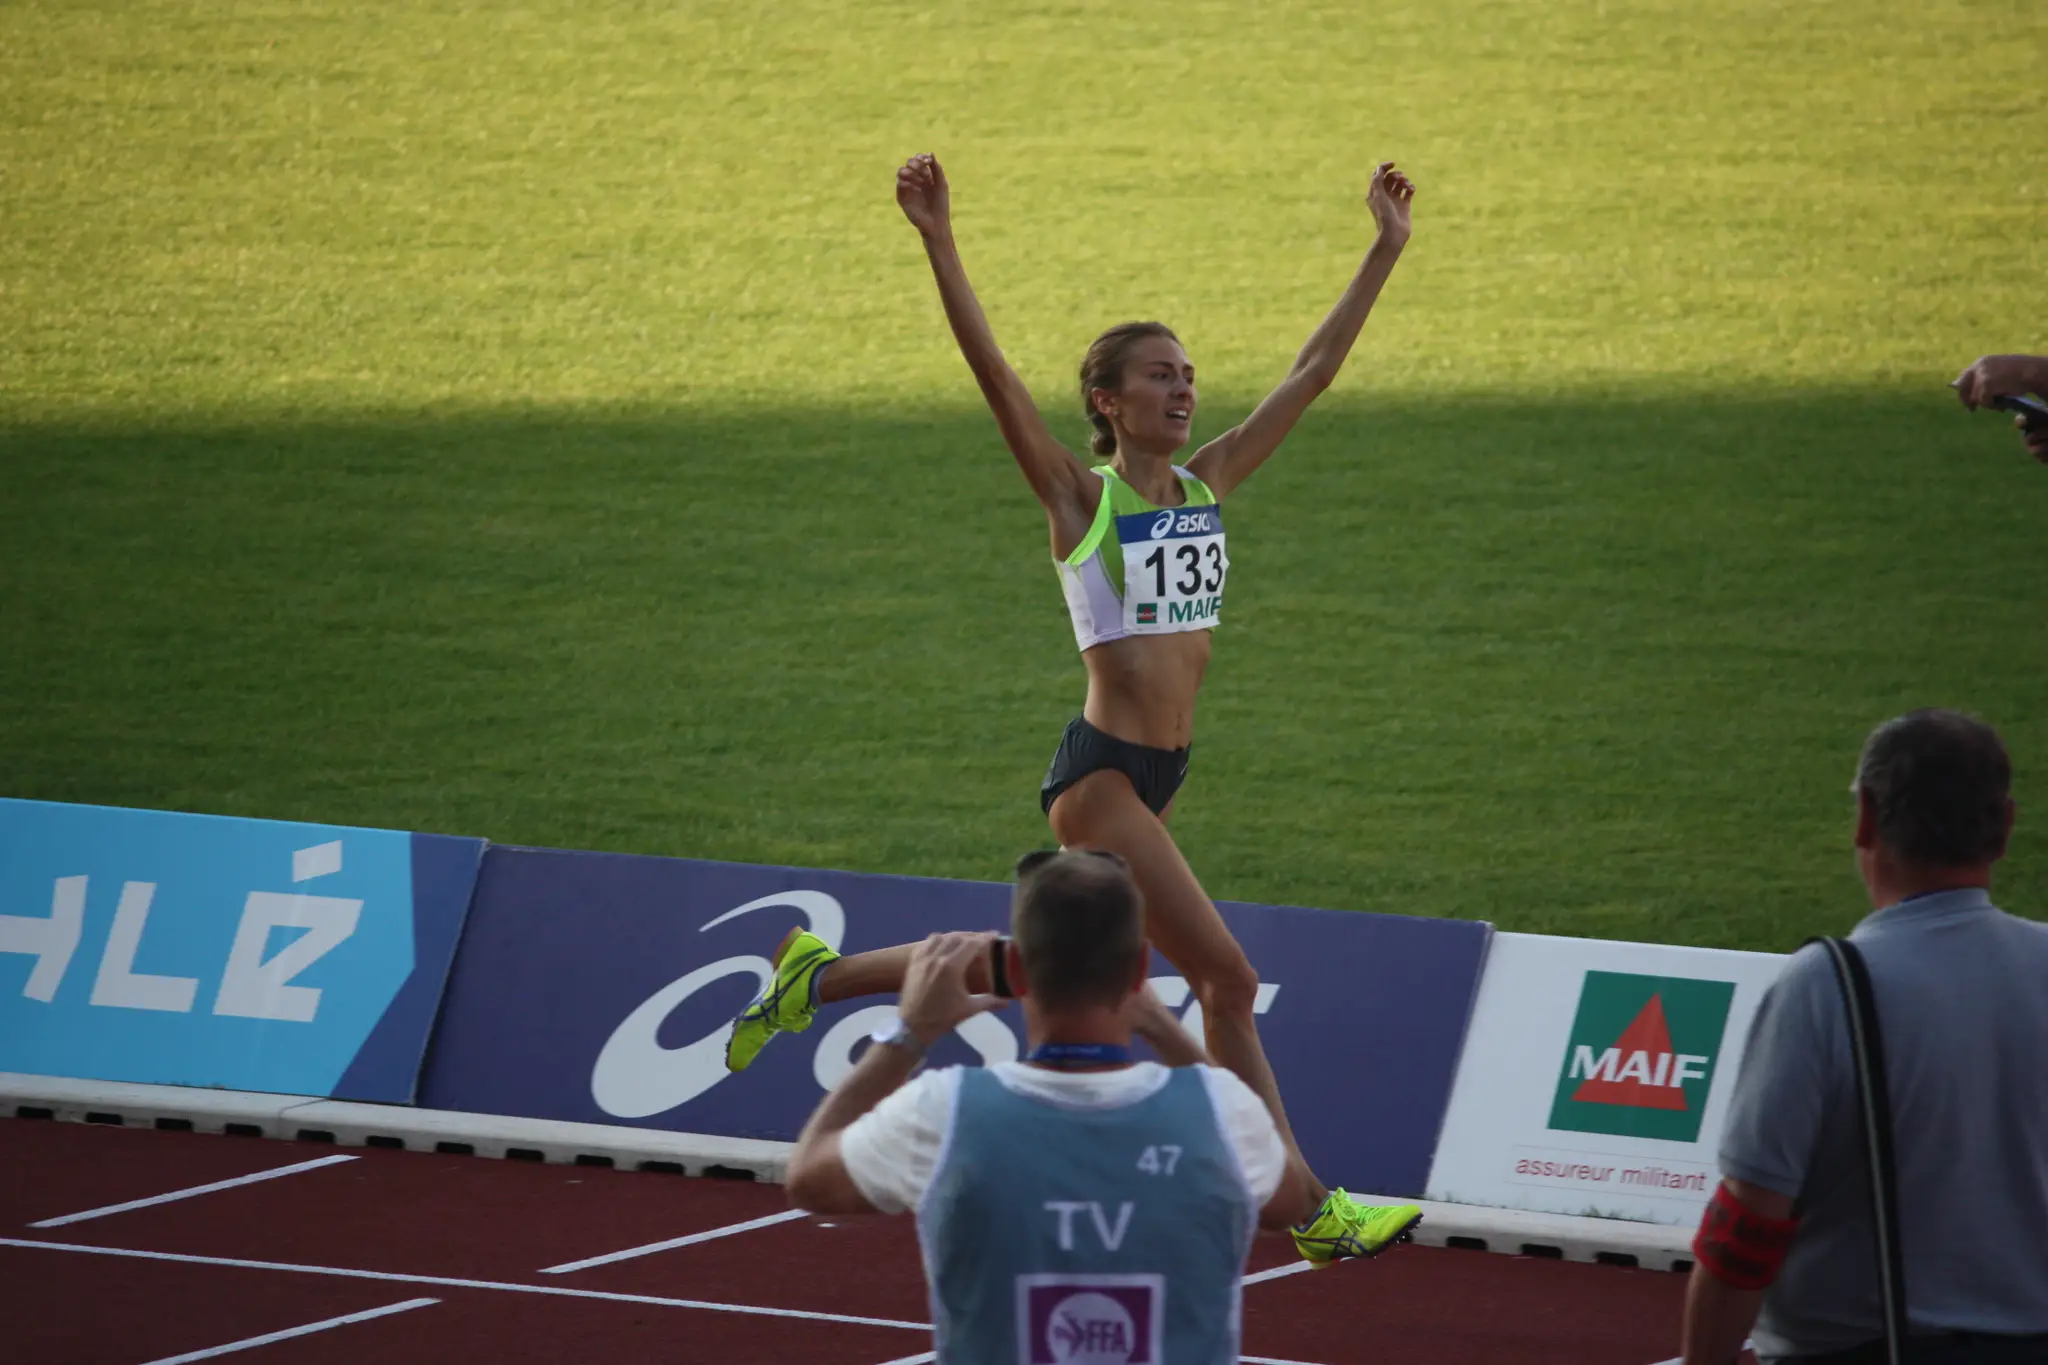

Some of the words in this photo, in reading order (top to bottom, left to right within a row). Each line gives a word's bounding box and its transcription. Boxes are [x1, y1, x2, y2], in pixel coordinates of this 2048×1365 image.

[1145, 543, 1223, 597] 133
[1168, 597, 1223, 623] MAIF
[1568, 1045, 1709, 1088] MAIF
[1136, 1145, 1183, 1175] 47
[1515, 1158, 1615, 1182] assureur
[1620, 1167, 1708, 1191] militant
[1043, 1201, 1134, 1251] TV
[1086, 1320, 1128, 1354] FFA
